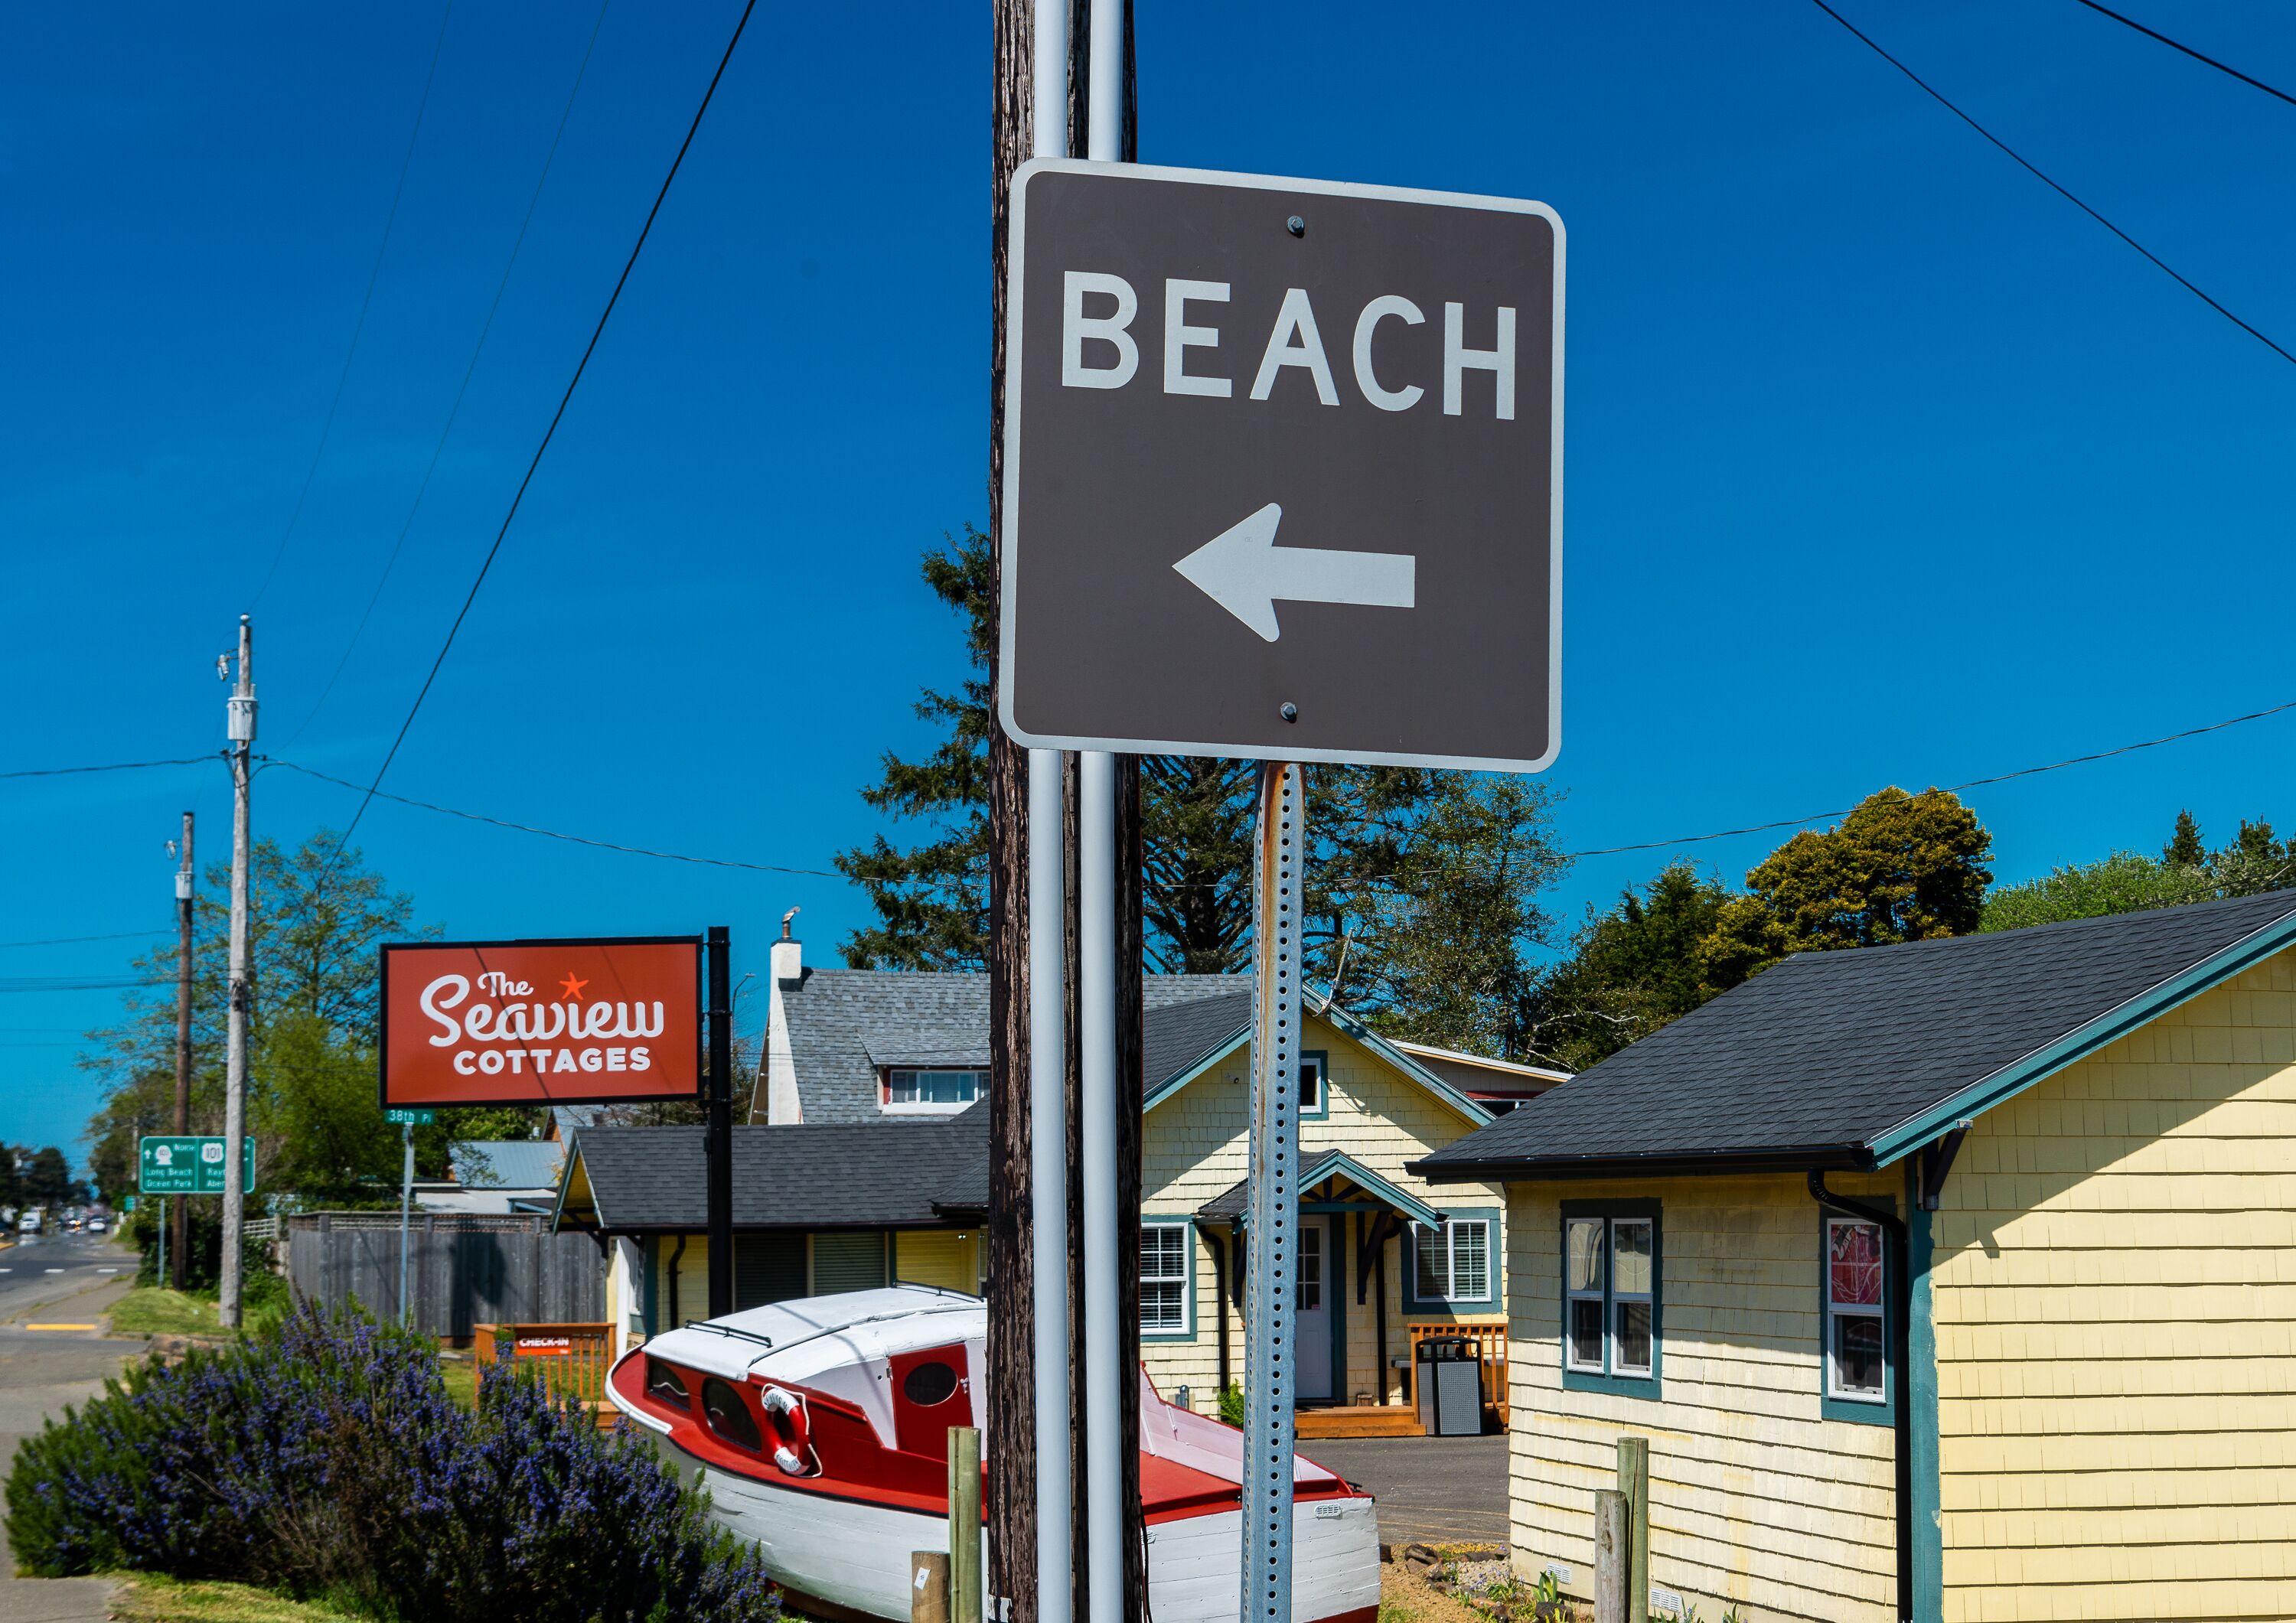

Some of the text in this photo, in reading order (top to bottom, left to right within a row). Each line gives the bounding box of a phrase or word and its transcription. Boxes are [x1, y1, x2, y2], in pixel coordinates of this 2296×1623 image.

[1062, 270, 1516, 420] BEACH
[478, 971, 533, 998] The
[419, 973, 664, 1048] Seaview
[453, 1046, 651, 1075] COTTAGES
[388, 1110, 415, 1121] 38th
[205, 1147, 221, 1159] 101
[146, 1168, 193, 1178] Long Beach
[207, 1179, 226, 1188] Aber
[519, 1338, 569, 1347] CHECK-IN
